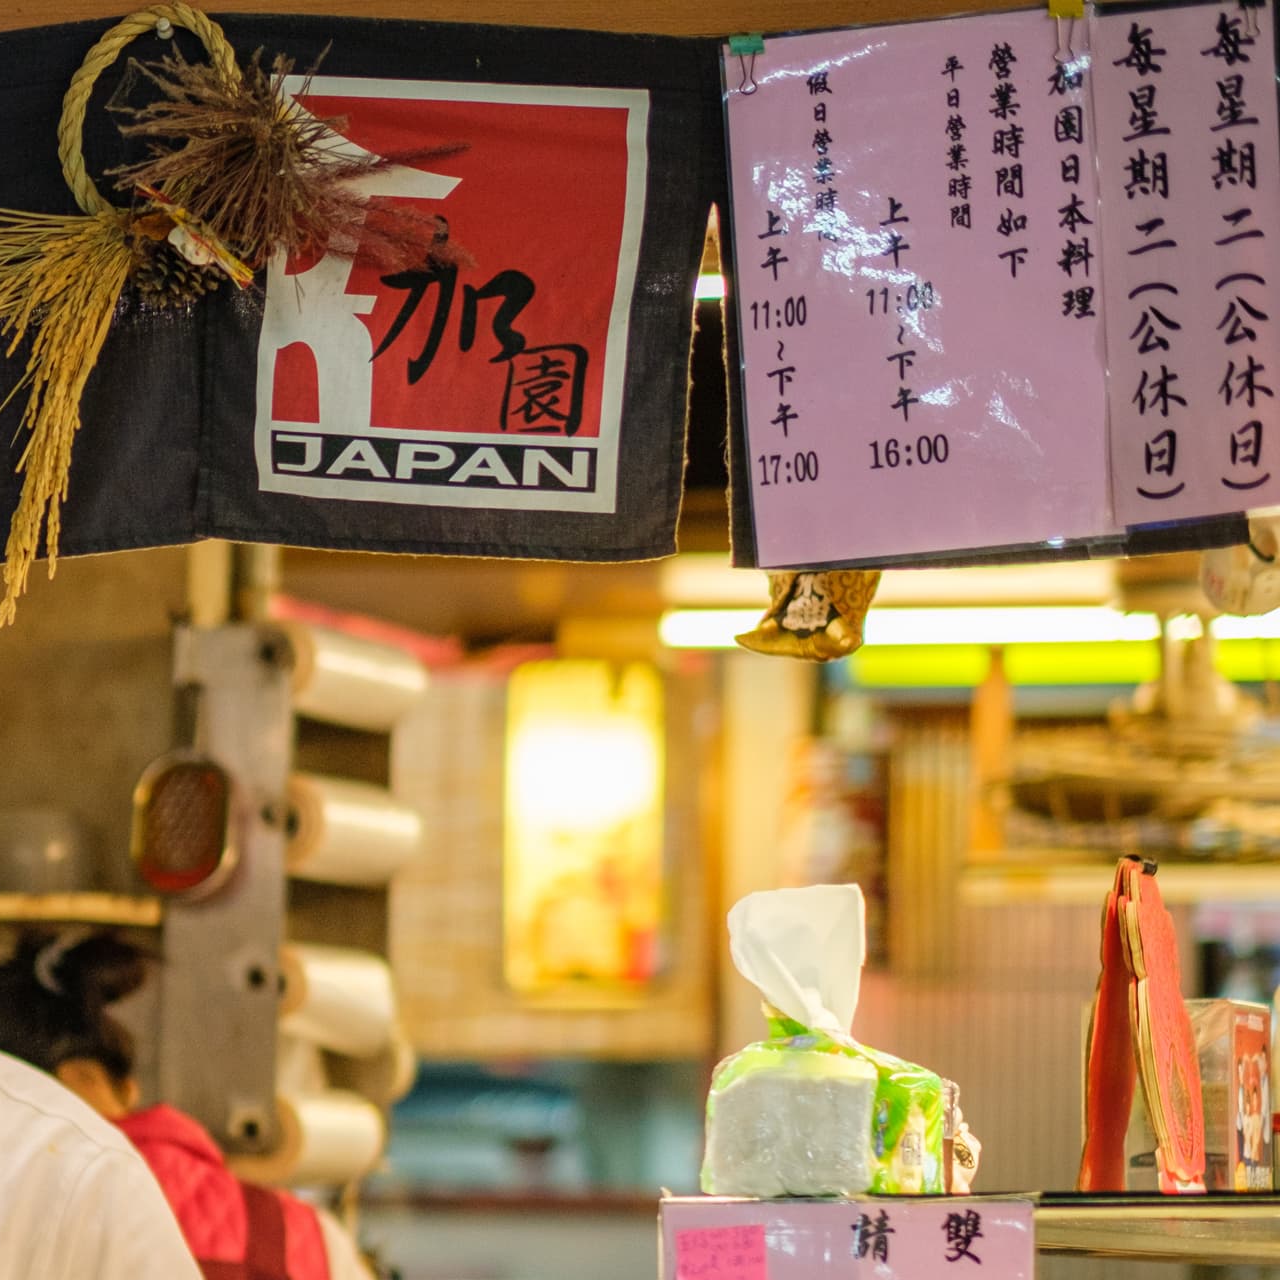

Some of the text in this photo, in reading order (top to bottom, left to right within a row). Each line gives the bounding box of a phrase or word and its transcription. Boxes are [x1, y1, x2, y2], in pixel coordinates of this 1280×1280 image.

[806, 72, 838, 242] 假日營業時
[941, 55, 972, 229] 平日營業時間
[988, 42, 1028, 278] 營業時間如下
[749, 297, 808, 331] 11:00
[1113, 21, 1188, 500] 每星期二（公休日）
[275, 433, 590, 488] JAPAN
[758, 451, 819, 486] 17:00
[868, 434, 950, 470] 16:00
